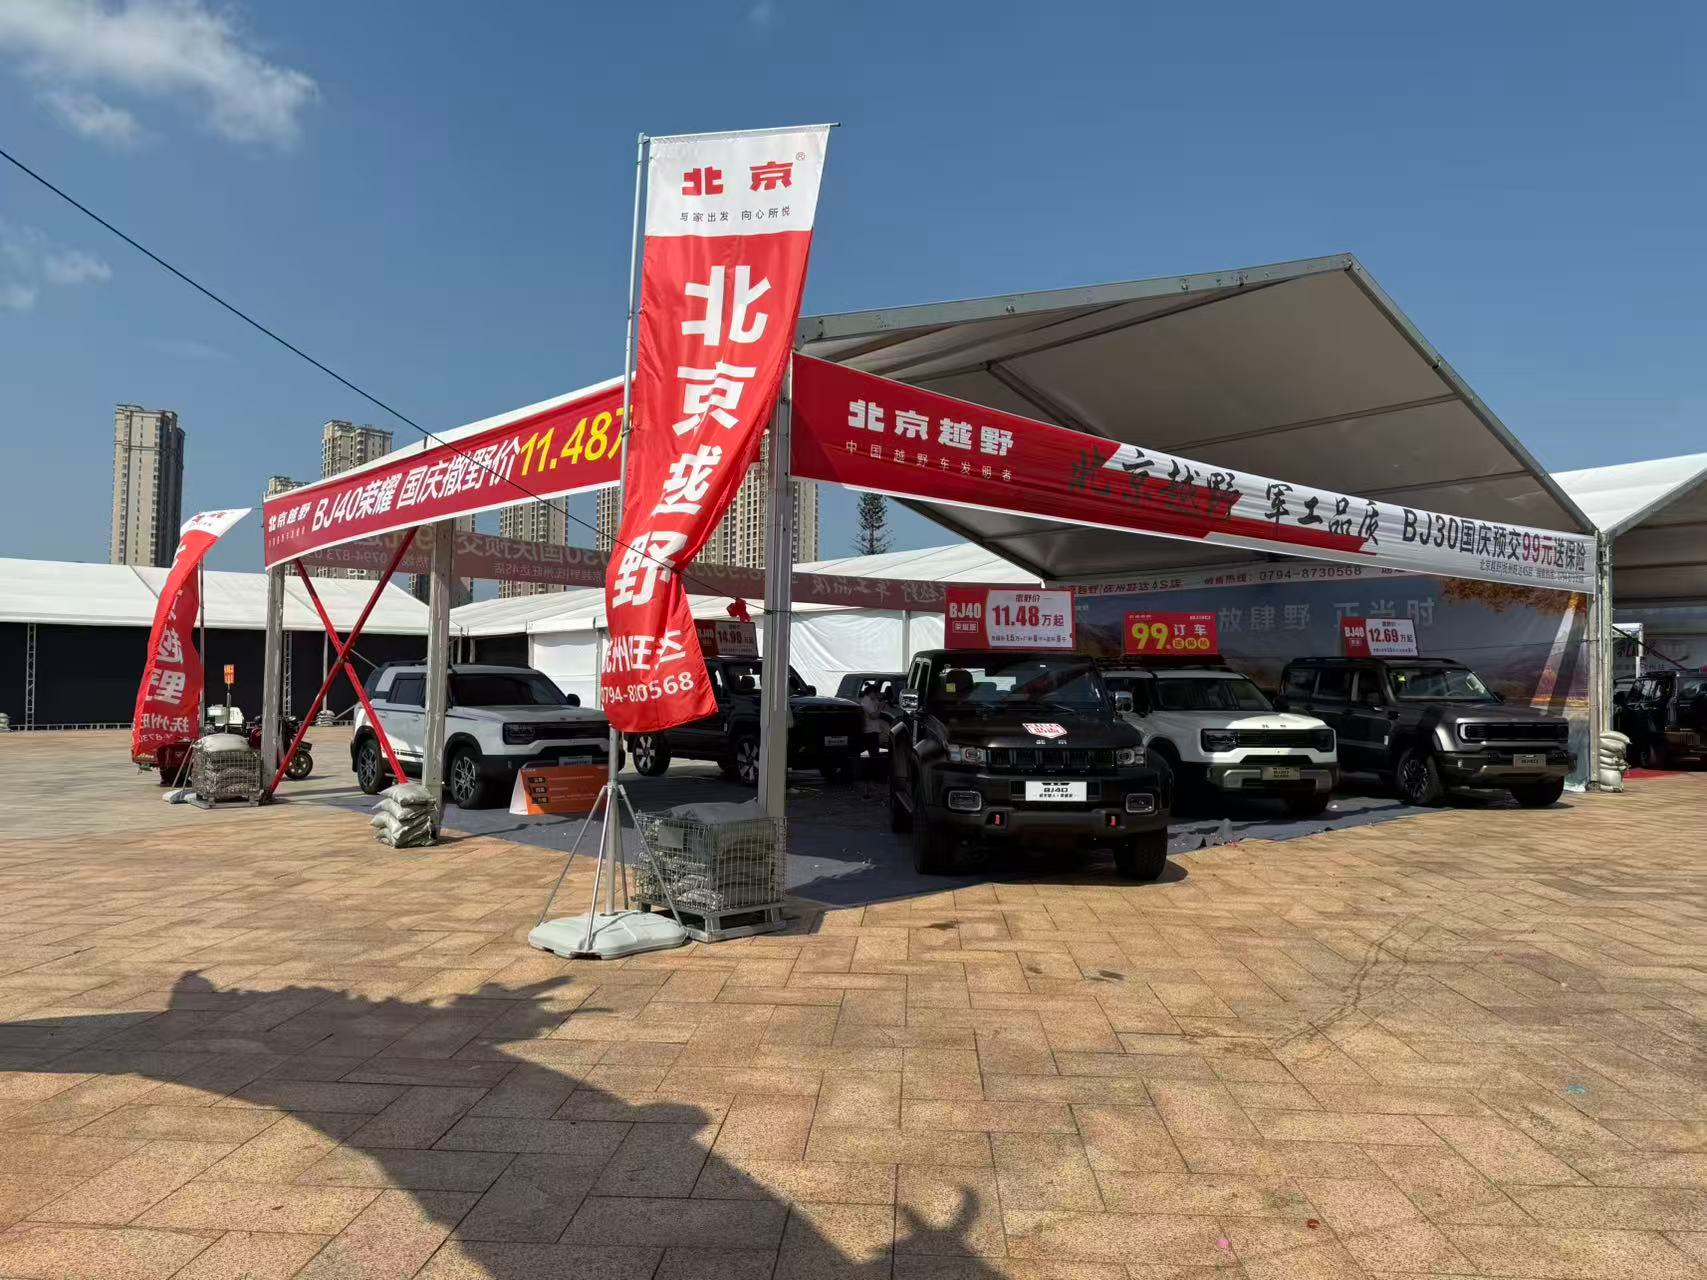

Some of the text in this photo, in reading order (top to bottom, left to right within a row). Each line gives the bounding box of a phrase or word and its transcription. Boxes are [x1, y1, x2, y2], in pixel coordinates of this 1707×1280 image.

[682, 161, 793, 195] 北京
[742, 206, 790, 220] 向心所悦
[612, 265, 771, 608] 北京越野
[845, 440, 1013, 482] 中国越野车发明者
[847, 398, 1014, 456] 北京越野
[1265, 482, 1380, 546] 军工品质
[268, 502, 312, 532] 北京越野
[1259, 567, 1362, 581] 0794-8730568
[949, 602, 982, 619] BJ40
[1174, 624, 1207, 636] 订车
